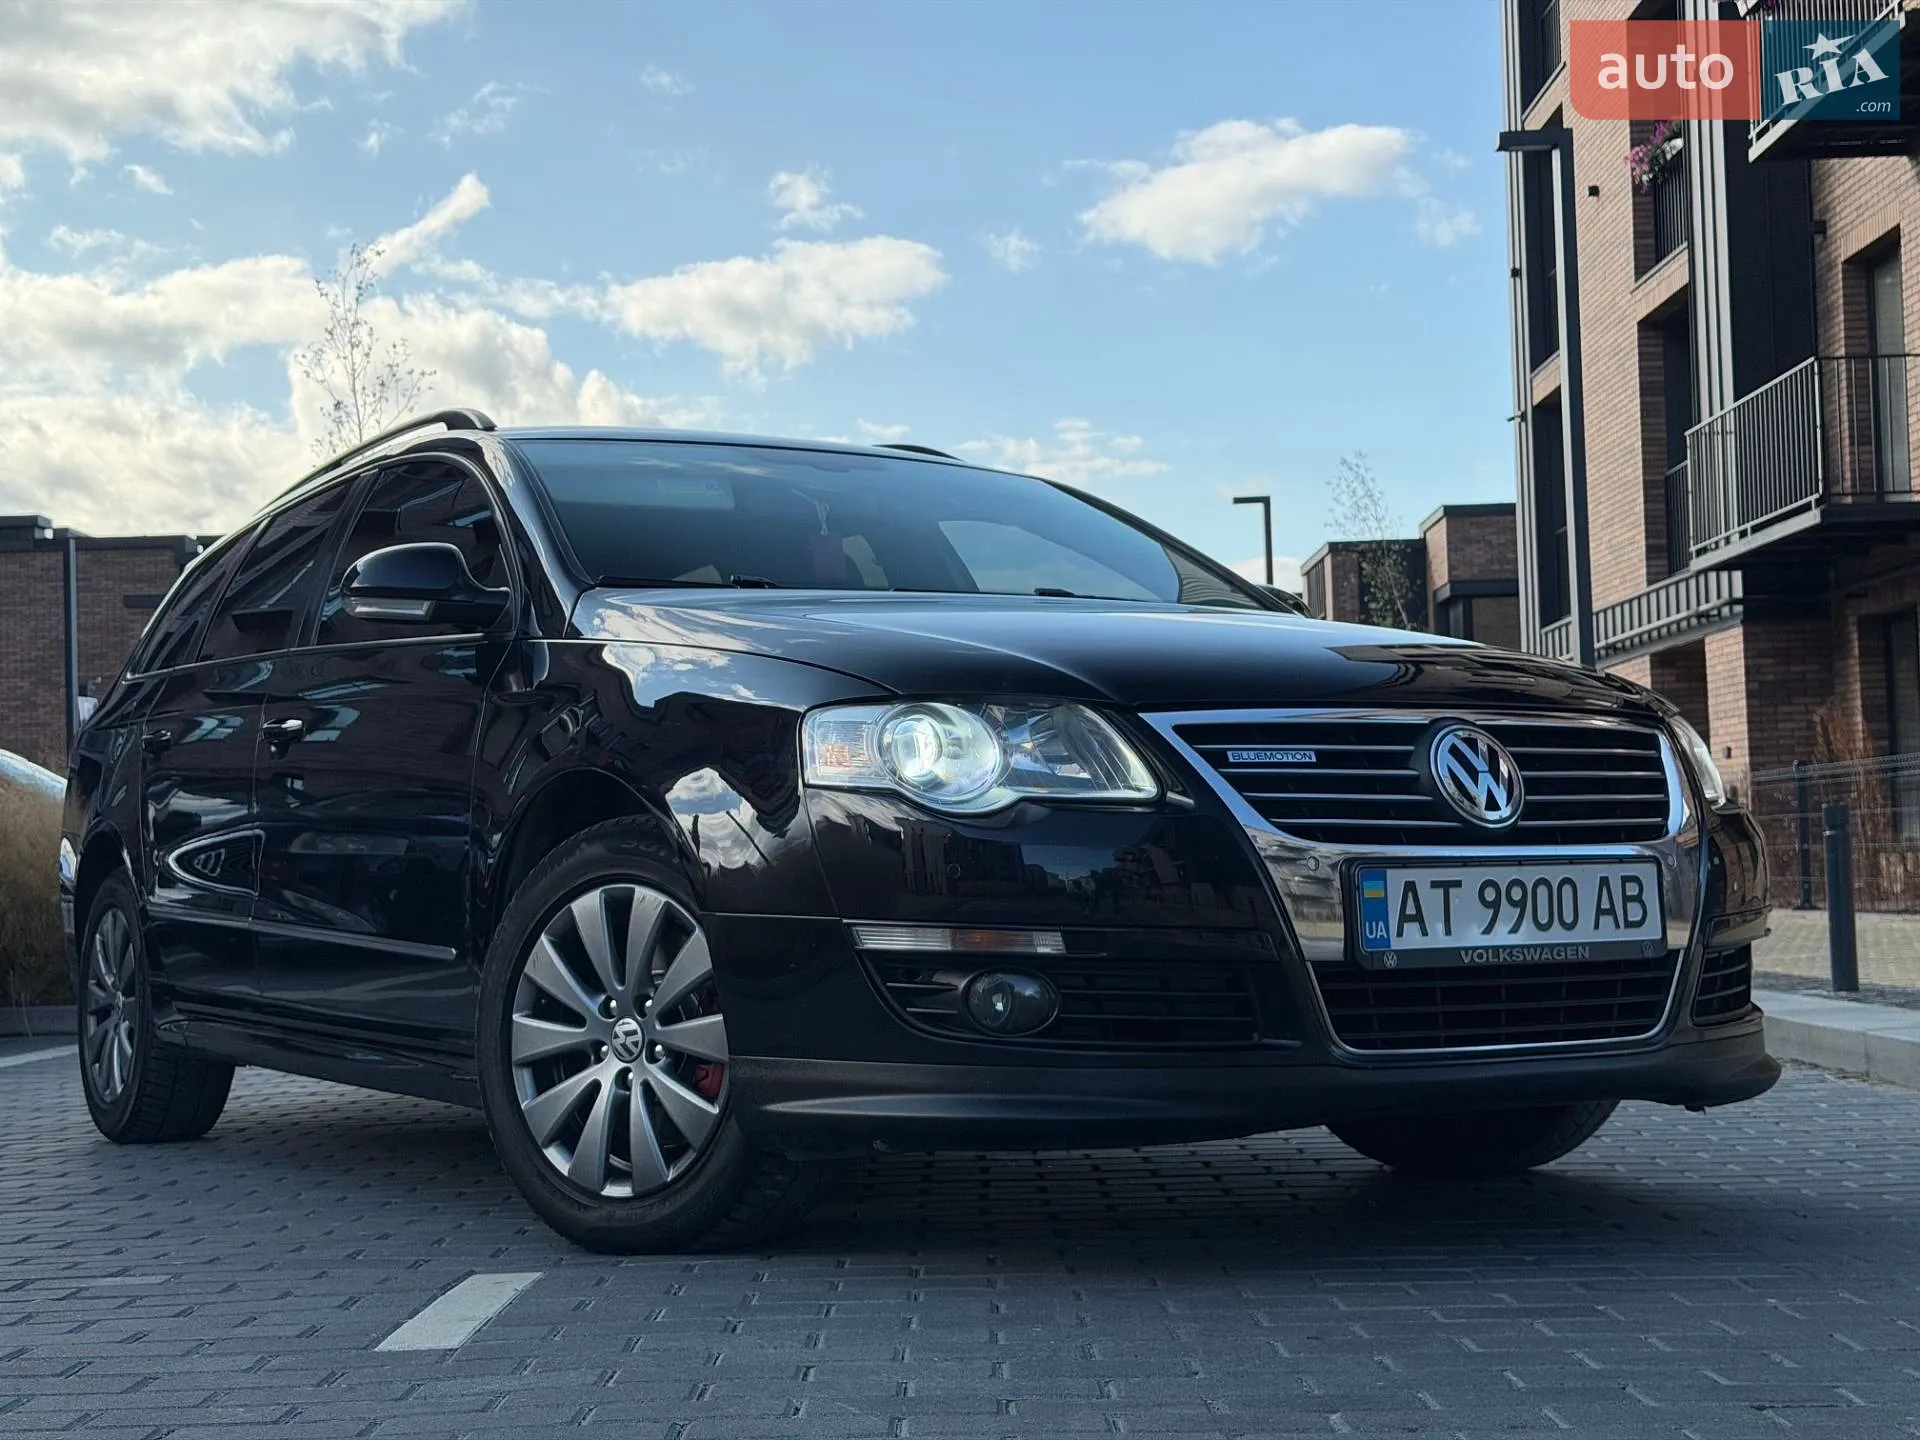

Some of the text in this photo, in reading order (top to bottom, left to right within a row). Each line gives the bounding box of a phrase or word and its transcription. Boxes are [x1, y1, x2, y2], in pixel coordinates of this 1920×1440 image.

[1231, 751, 1312, 762] BLUEMOTION
[1396, 874, 1649, 937] AT 9900 AB
[1365, 921, 1388, 940] UA
[1460, 946, 1590, 963] VOLKSWAGEN
